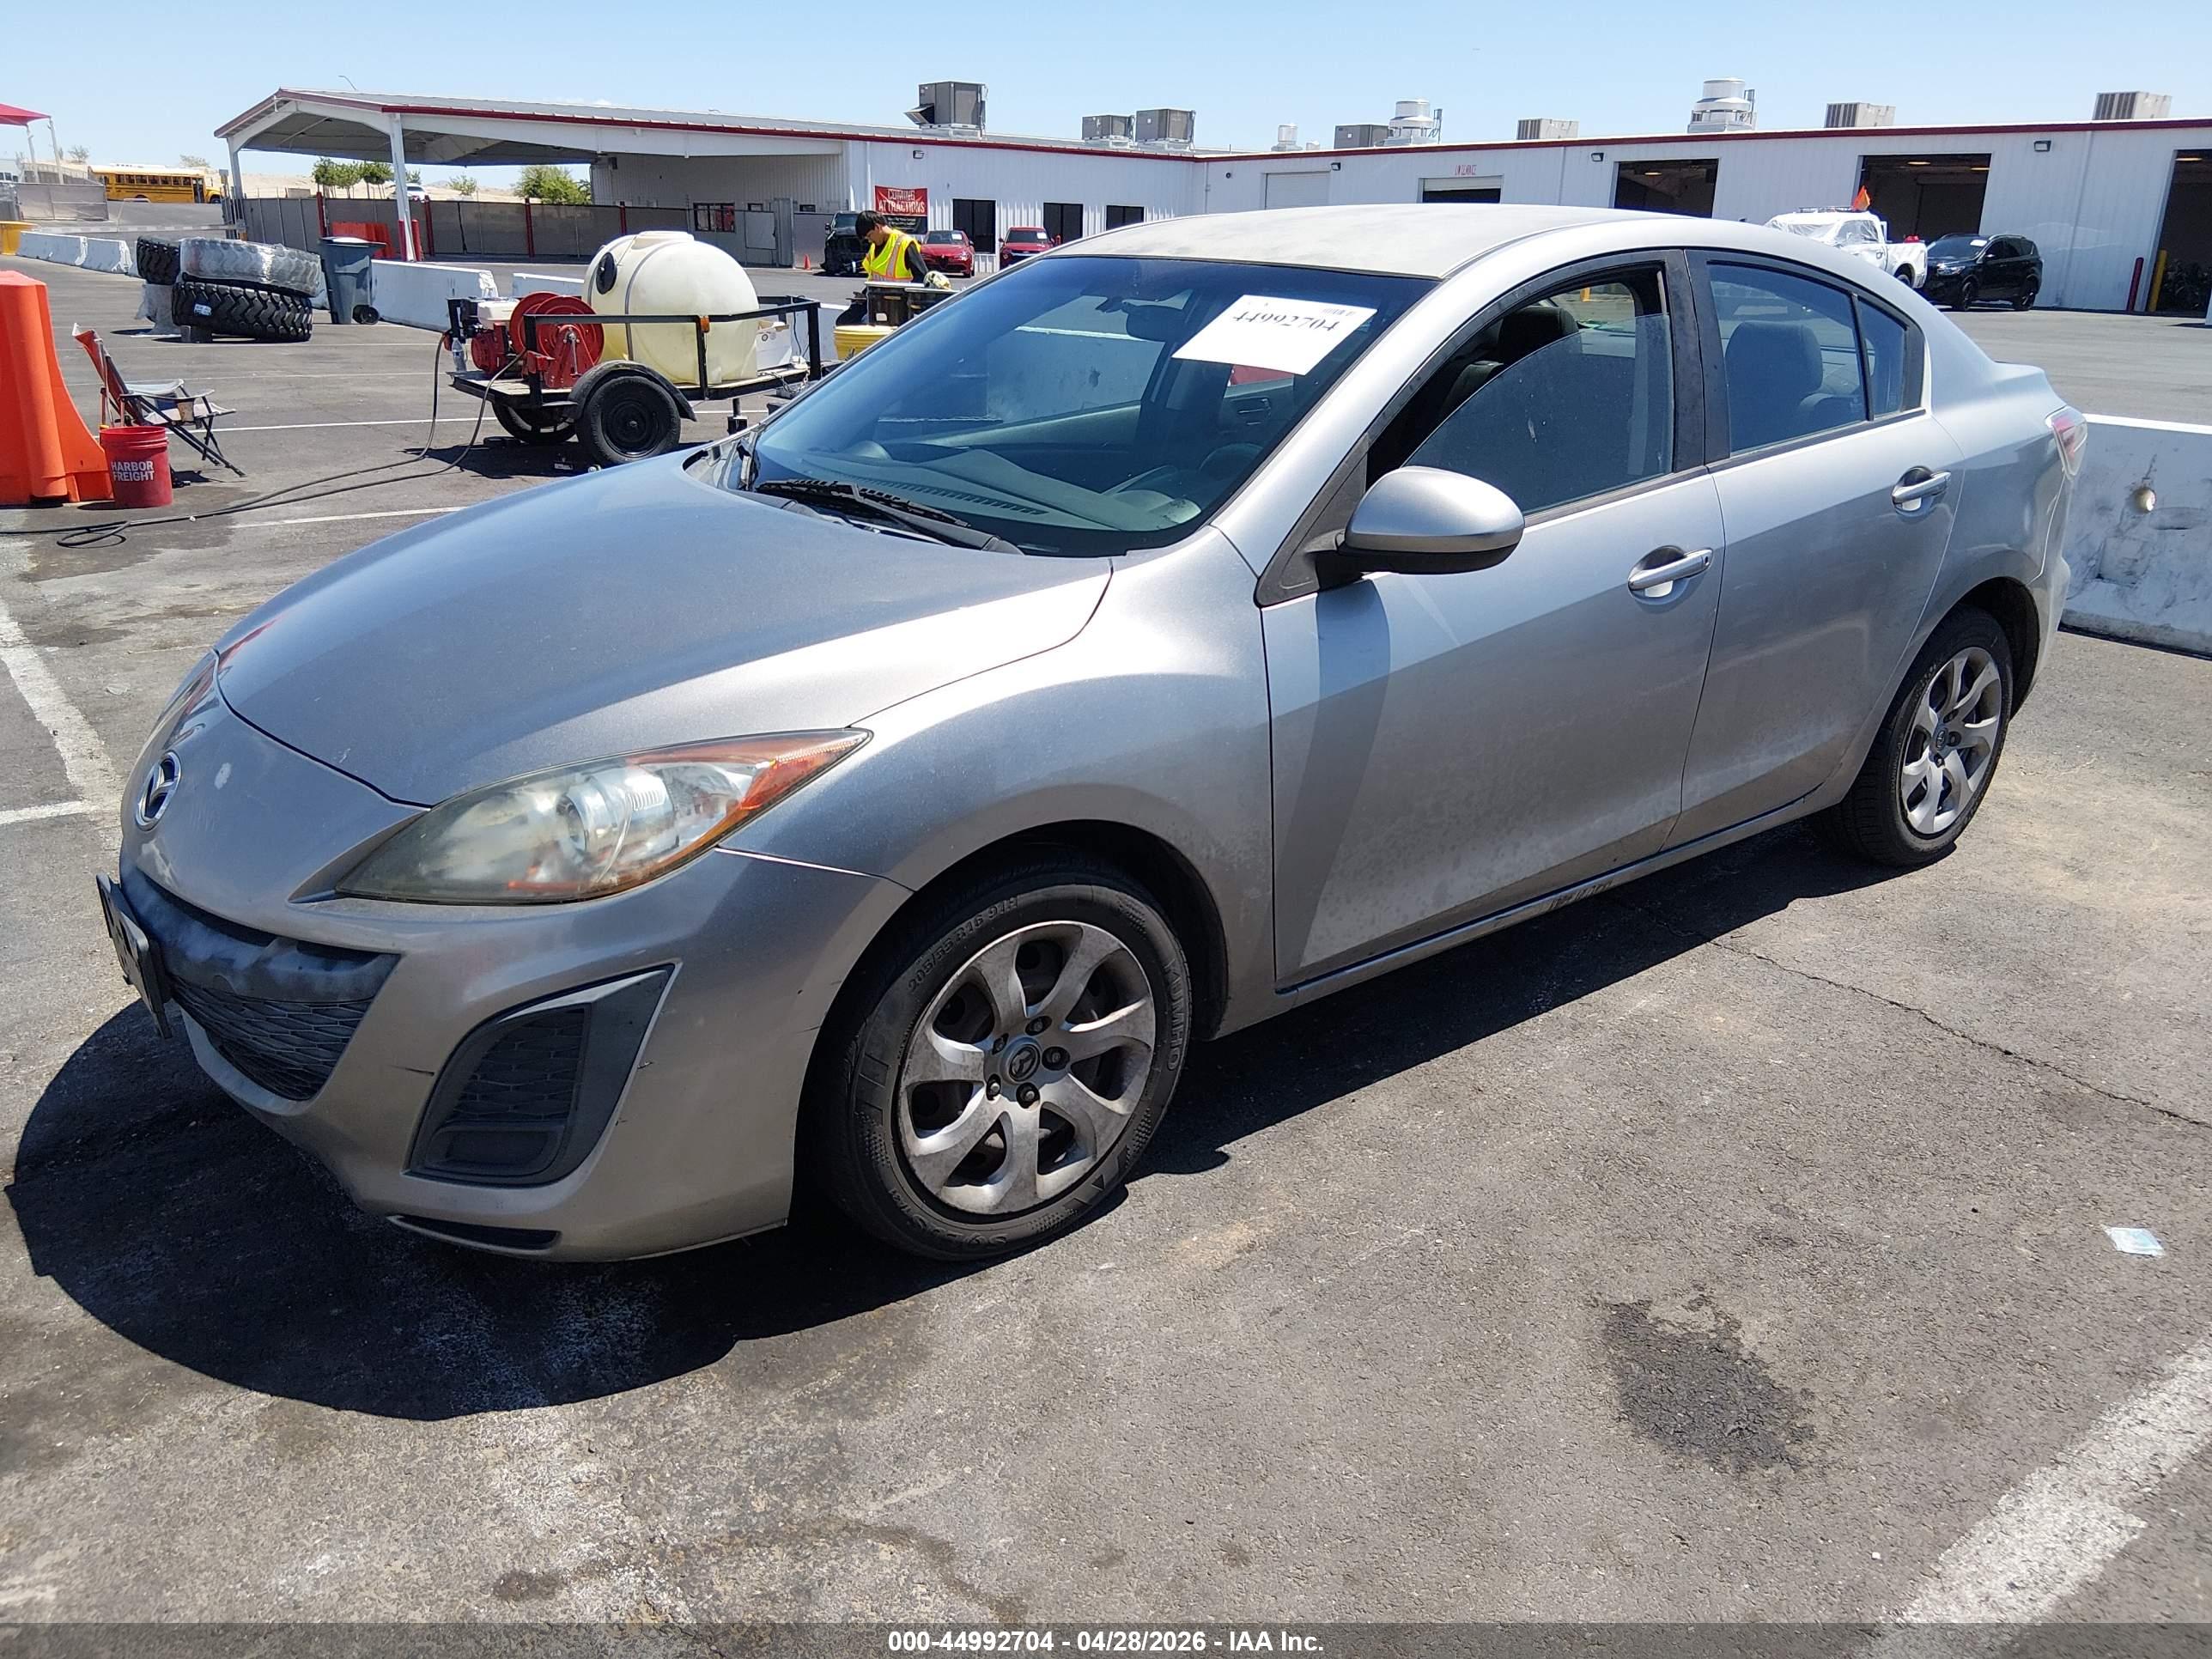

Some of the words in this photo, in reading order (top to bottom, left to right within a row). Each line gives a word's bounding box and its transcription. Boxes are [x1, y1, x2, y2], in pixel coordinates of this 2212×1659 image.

[878, 199, 926, 213] ATTRACTIONS
[1233, 311, 1340, 331] 44992704
[110, 460, 154, 471] HARBOR
[112, 471, 155, 482] FREIGHT
[1164, 957, 1185, 1071] KUMHO
